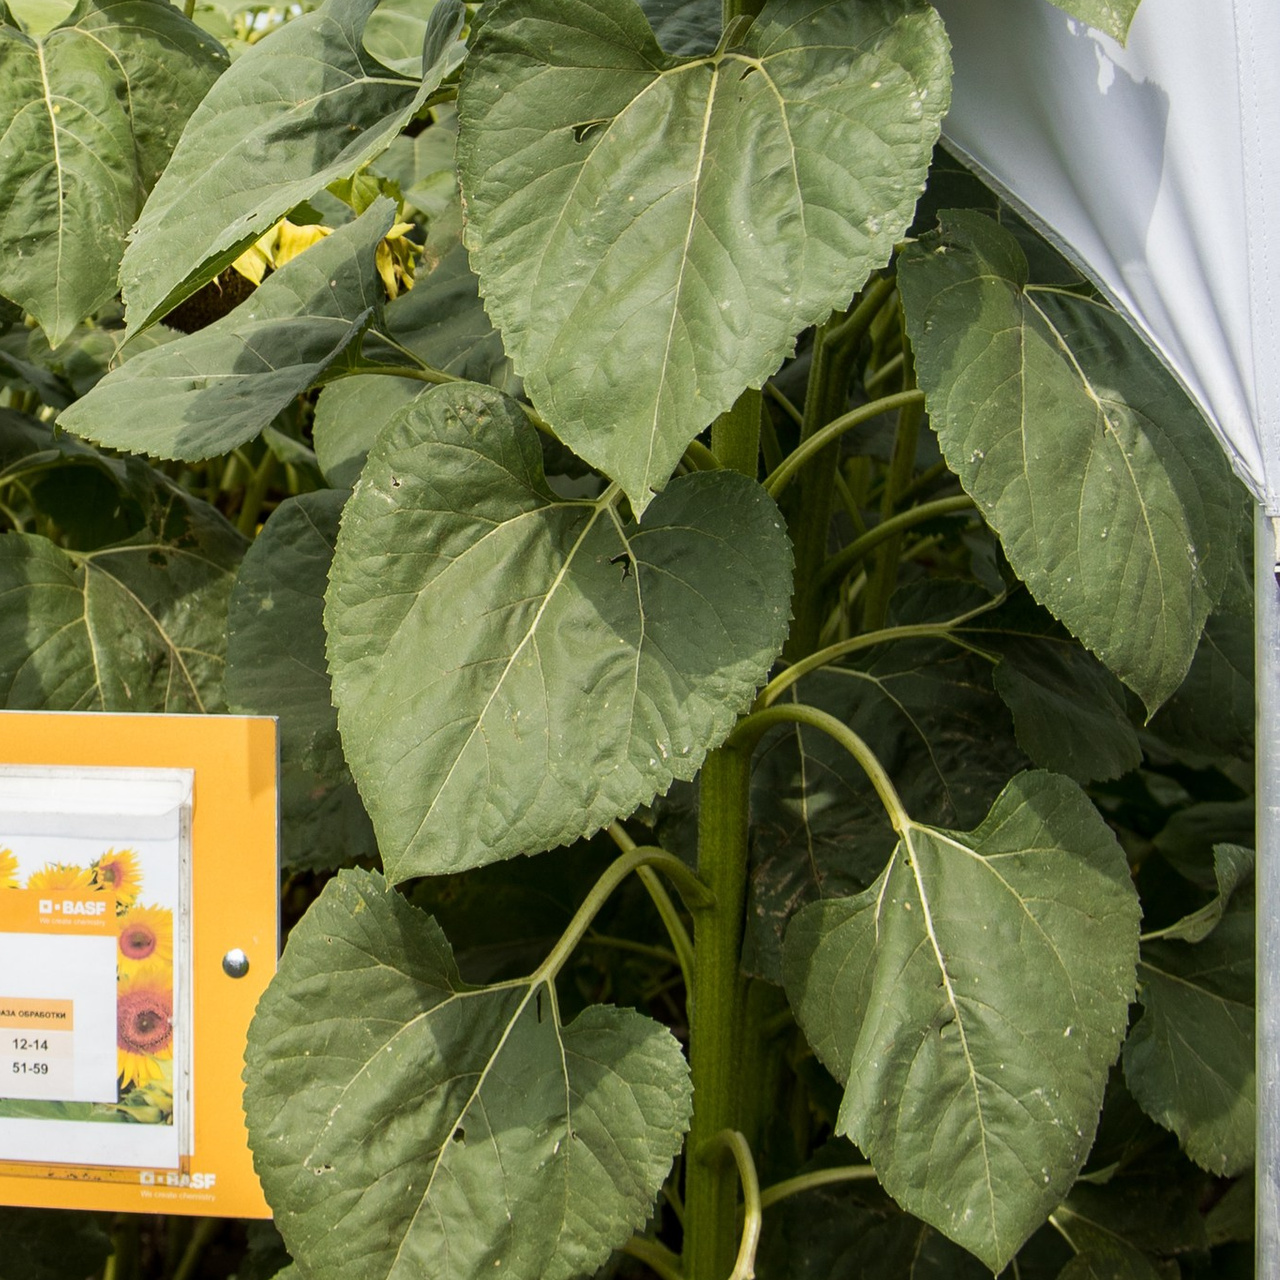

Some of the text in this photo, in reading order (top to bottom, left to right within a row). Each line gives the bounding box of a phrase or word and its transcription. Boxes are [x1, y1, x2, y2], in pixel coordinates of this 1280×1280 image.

[63, 901, 106, 916] BASF
[19, 1010, 66, 1019] ОБРАБОТКИ
[12, 1039, 48, 1051] 12-14
[12, 1062, 48, 1075] 51-59
[167, 1172, 216, 1189] BASF
